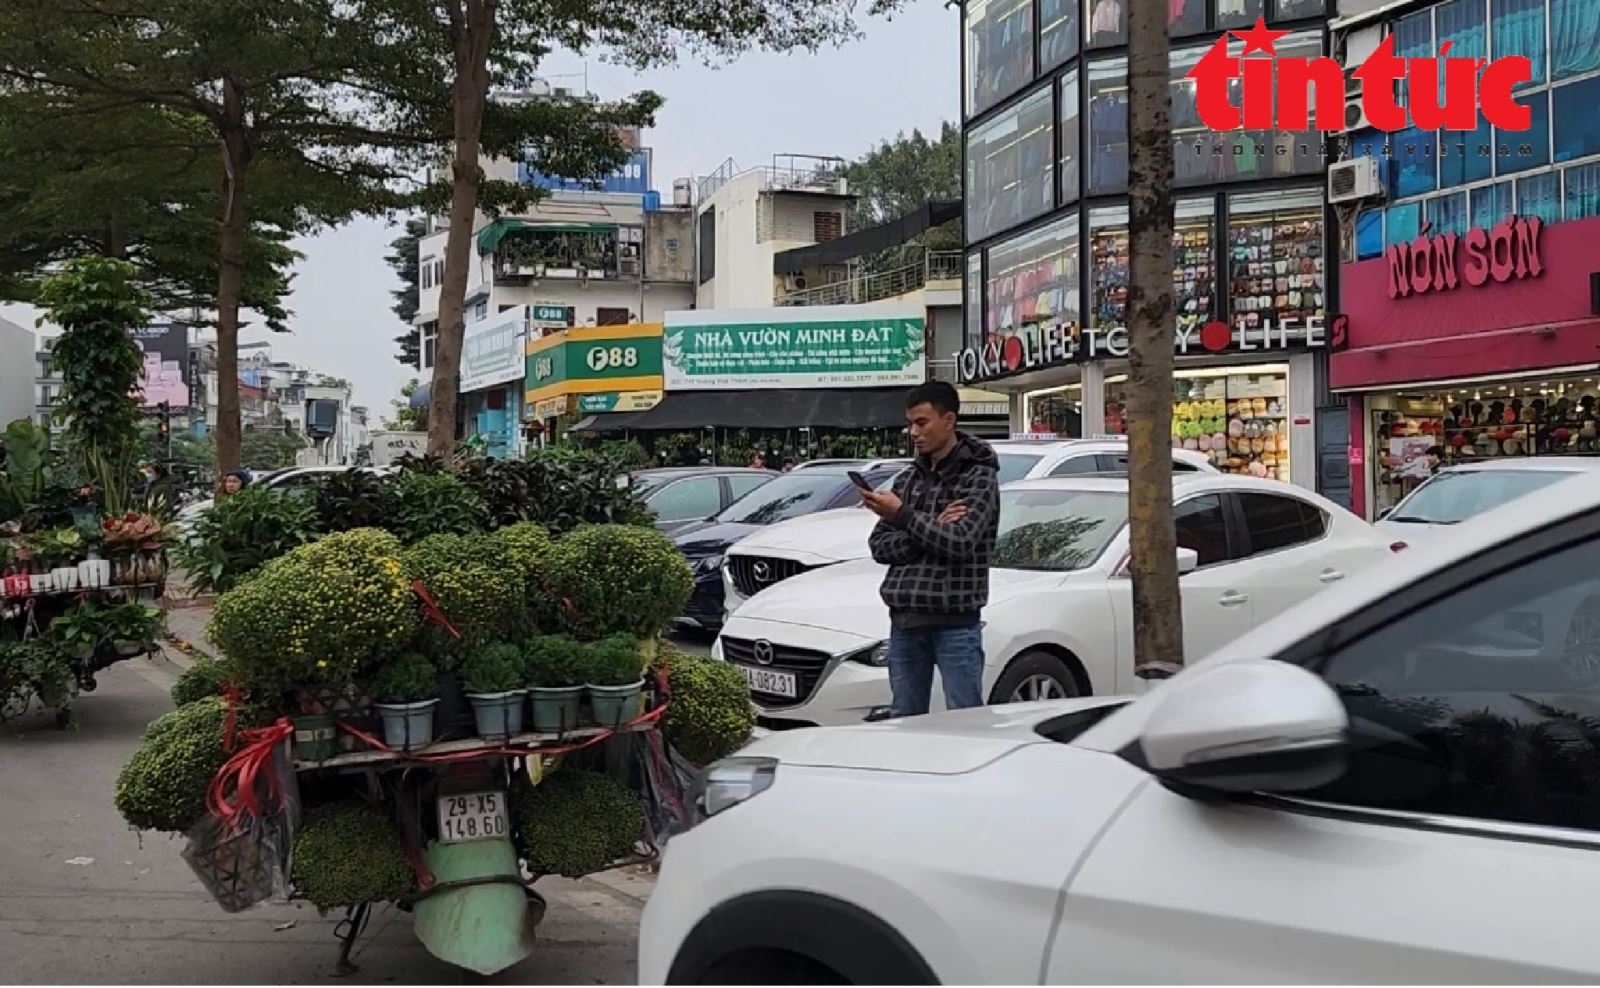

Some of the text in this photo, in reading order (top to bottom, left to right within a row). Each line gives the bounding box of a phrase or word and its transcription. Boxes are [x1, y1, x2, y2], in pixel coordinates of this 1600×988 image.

[1387, 221, 1459, 298] NÓN
[695, 327, 894, 347] NHÀ VƯỜN MINH ĐẠT
[586, 346, 638, 371] F88
[447, 793, 496, 817] 29-X5
